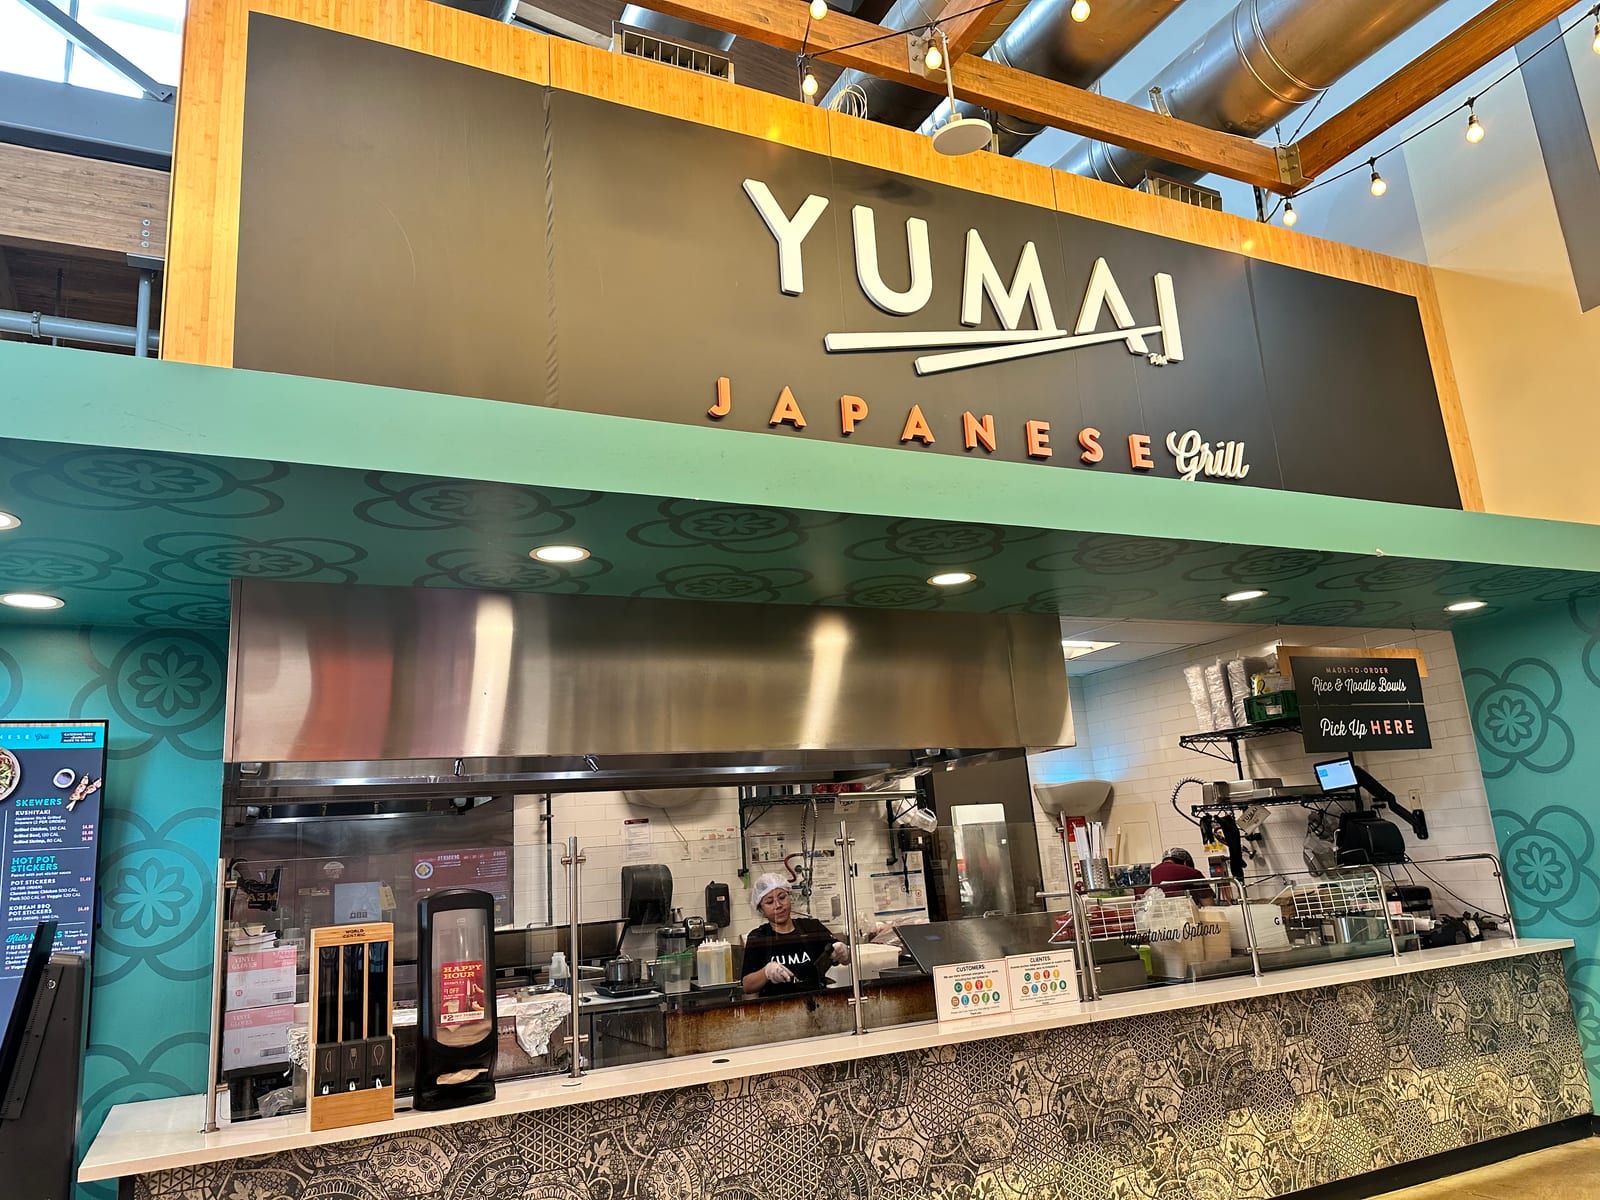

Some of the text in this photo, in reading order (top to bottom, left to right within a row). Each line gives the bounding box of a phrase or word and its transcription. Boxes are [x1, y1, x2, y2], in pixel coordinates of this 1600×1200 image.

[743, 178, 1185, 374] YUMAI
[707, 375, 1250, 482] JAPANESE Grill
[1311, 676, 1407, 696] Rice & Noodle Bowls
[1320, 717, 1415, 739] Pick Up HERE
[15, 798, 62, 807] SKEWERS
[11, 855, 56, 865] HOT POT
[10, 863, 58, 872] STICKERS
[1182, 921, 1222, 941] Options
[5, 932, 29, 944] Kids
[443, 964, 482, 973] HAPPY
[956, 964, 985, 972] CUSTOMERS
[443, 971, 475, 979] HOUR
